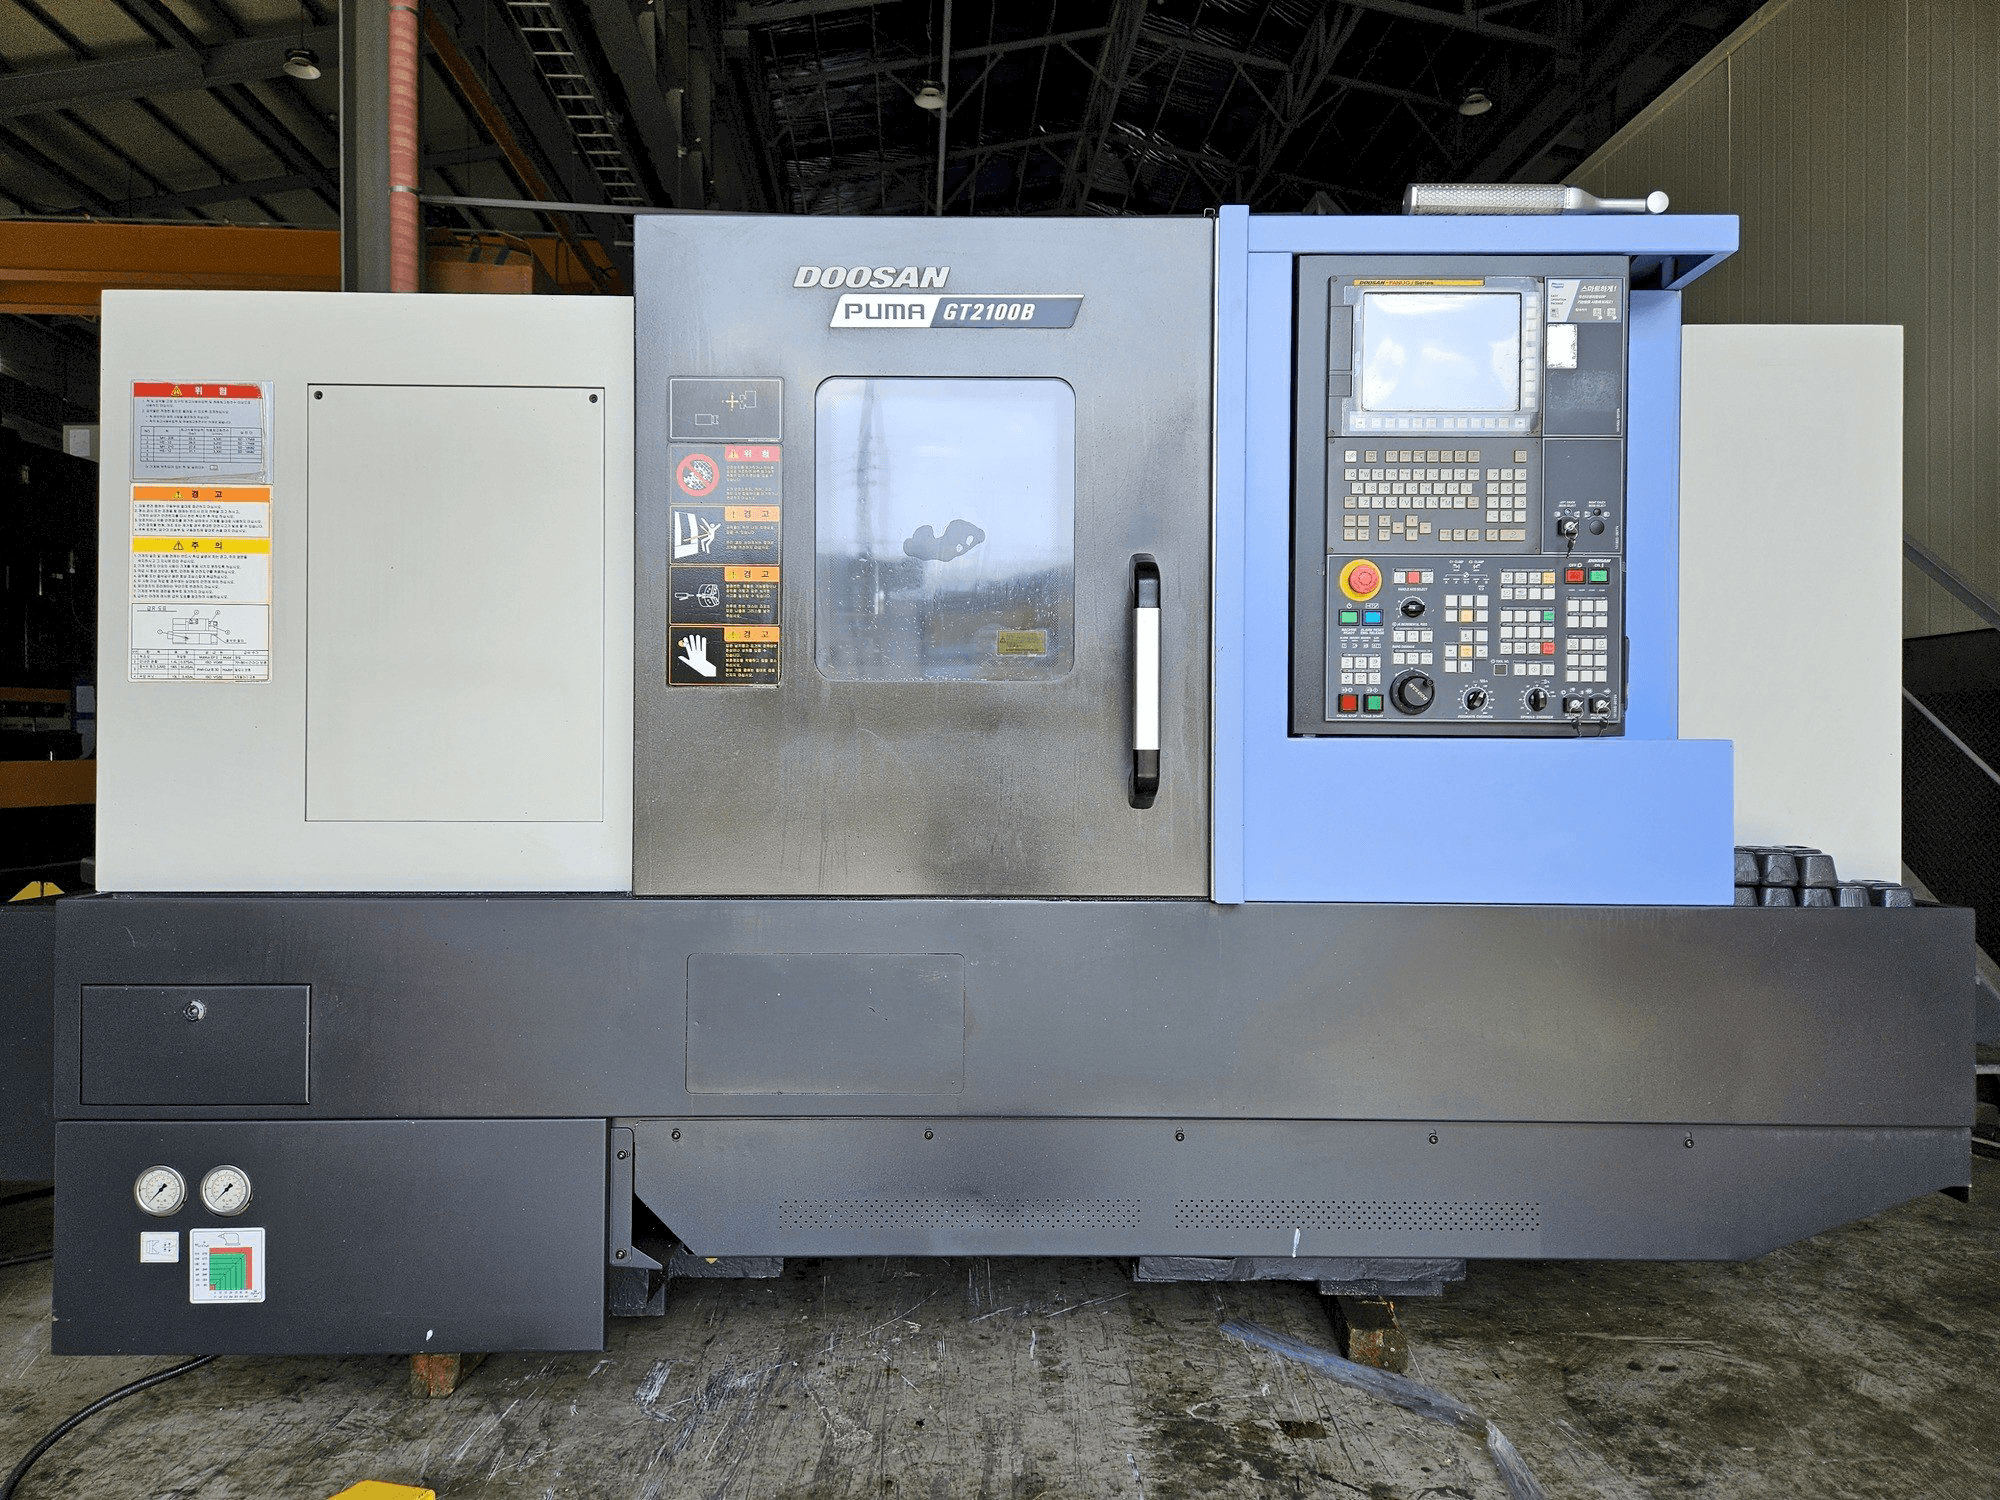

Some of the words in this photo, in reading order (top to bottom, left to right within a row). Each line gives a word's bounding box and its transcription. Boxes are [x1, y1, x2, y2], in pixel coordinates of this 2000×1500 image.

[793, 266, 951, 289] DOOSAN
[844, 303, 925, 320] PUMA
[942, 303, 1036, 321] GT2100B
